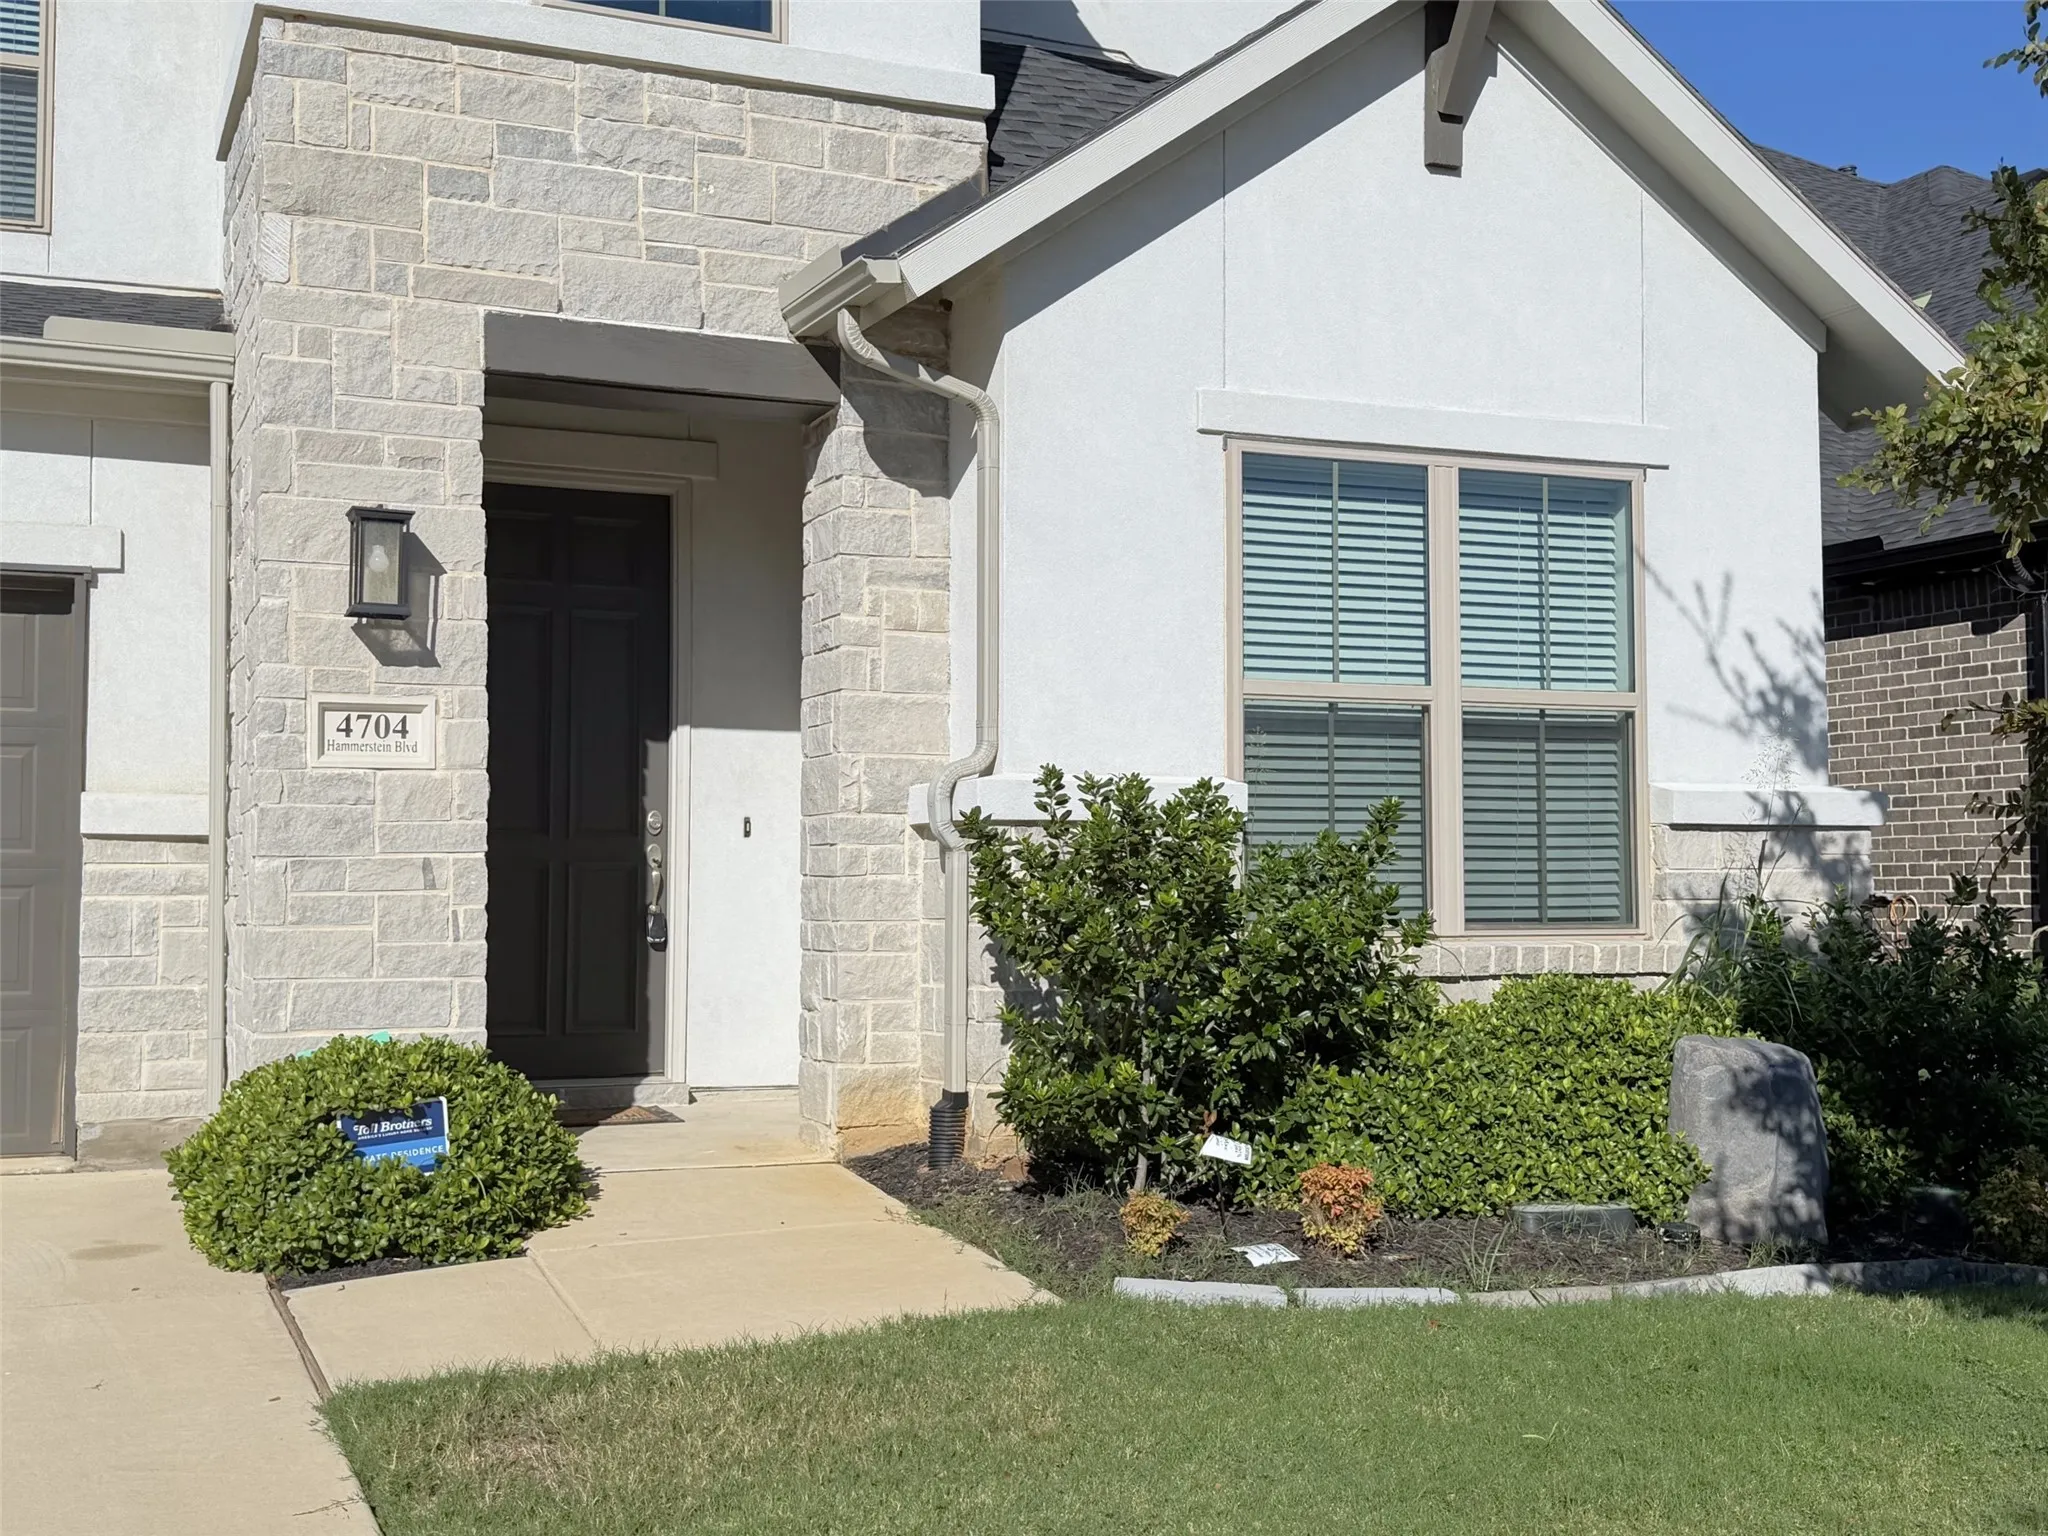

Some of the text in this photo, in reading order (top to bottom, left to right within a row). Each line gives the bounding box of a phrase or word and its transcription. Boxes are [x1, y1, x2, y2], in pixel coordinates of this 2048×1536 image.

[336, 713, 409, 739] 4704
[327, 739, 418, 753] Hammerstein Blvd
[353, 1118, 432, 1135] Toll Brothers
